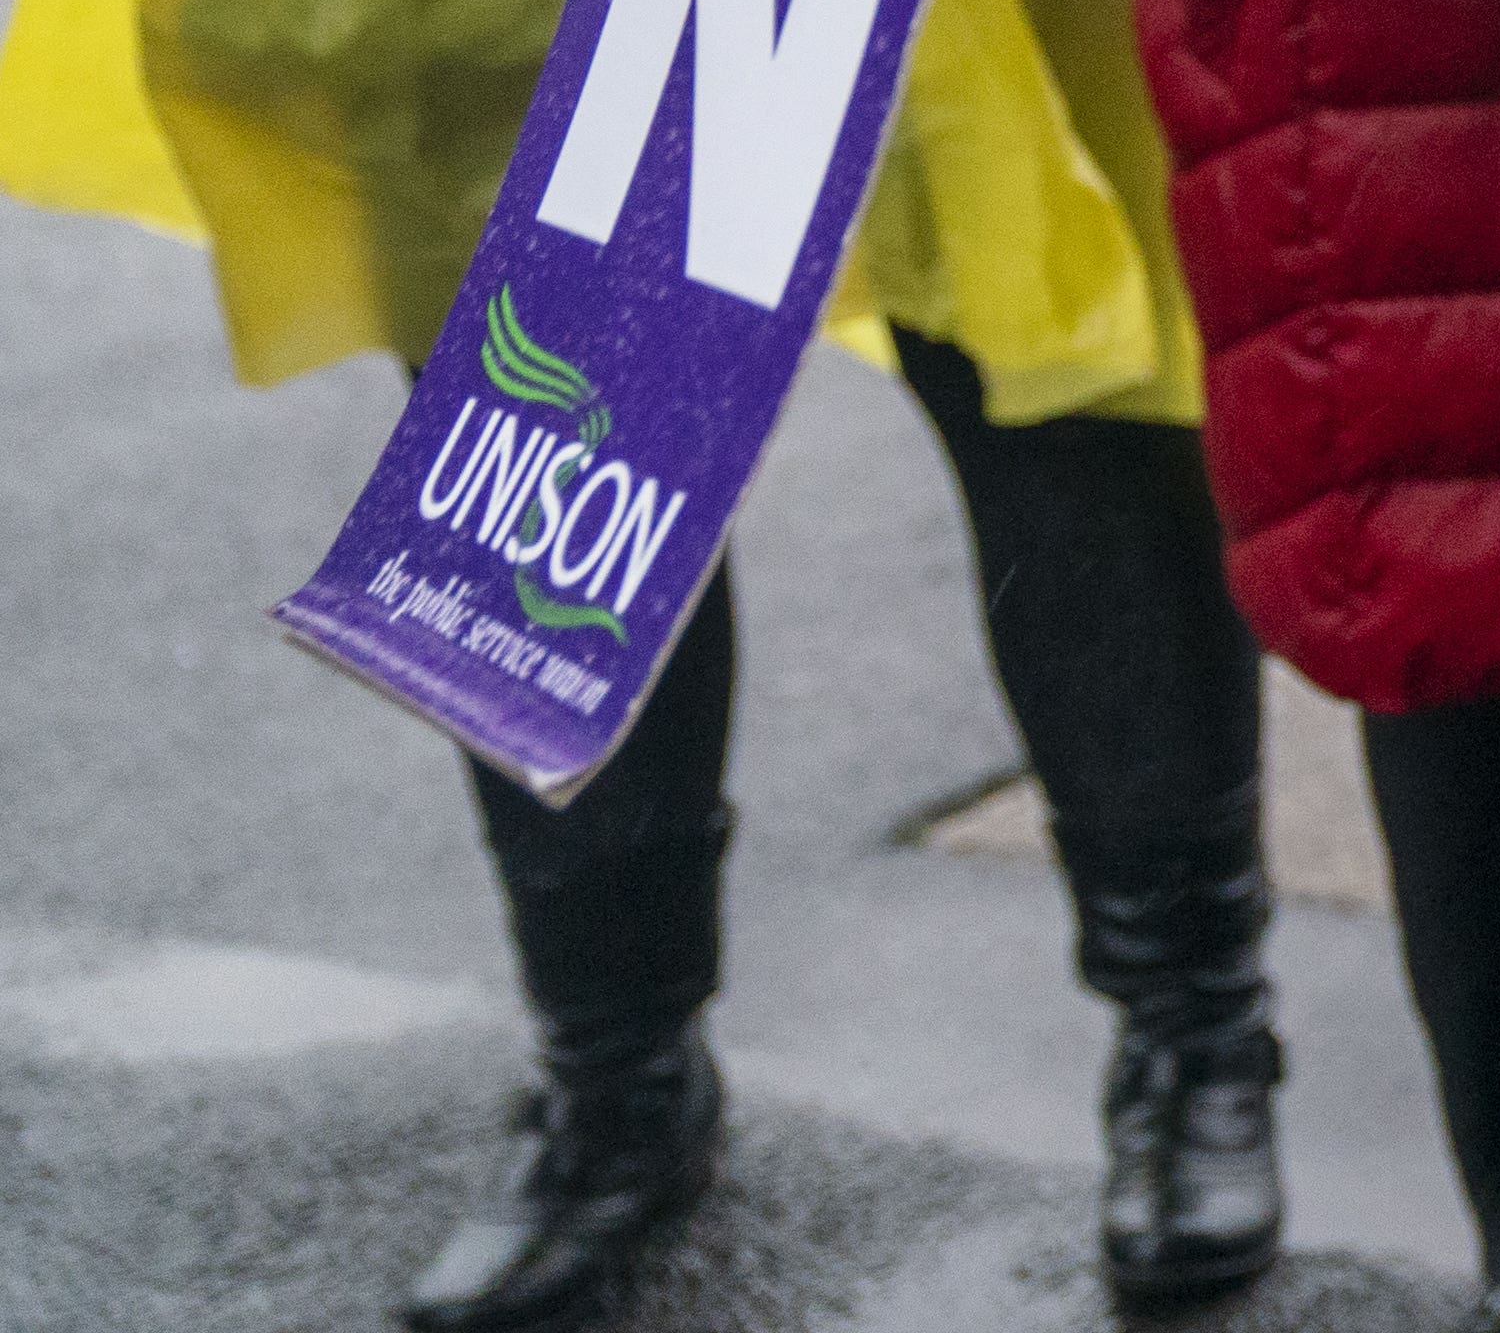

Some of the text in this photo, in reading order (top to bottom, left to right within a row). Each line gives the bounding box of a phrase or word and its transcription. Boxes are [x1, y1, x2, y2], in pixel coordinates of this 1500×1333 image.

[419, 398, 687, 615] UNISON
[366, 550, 611, 715] the public service union
